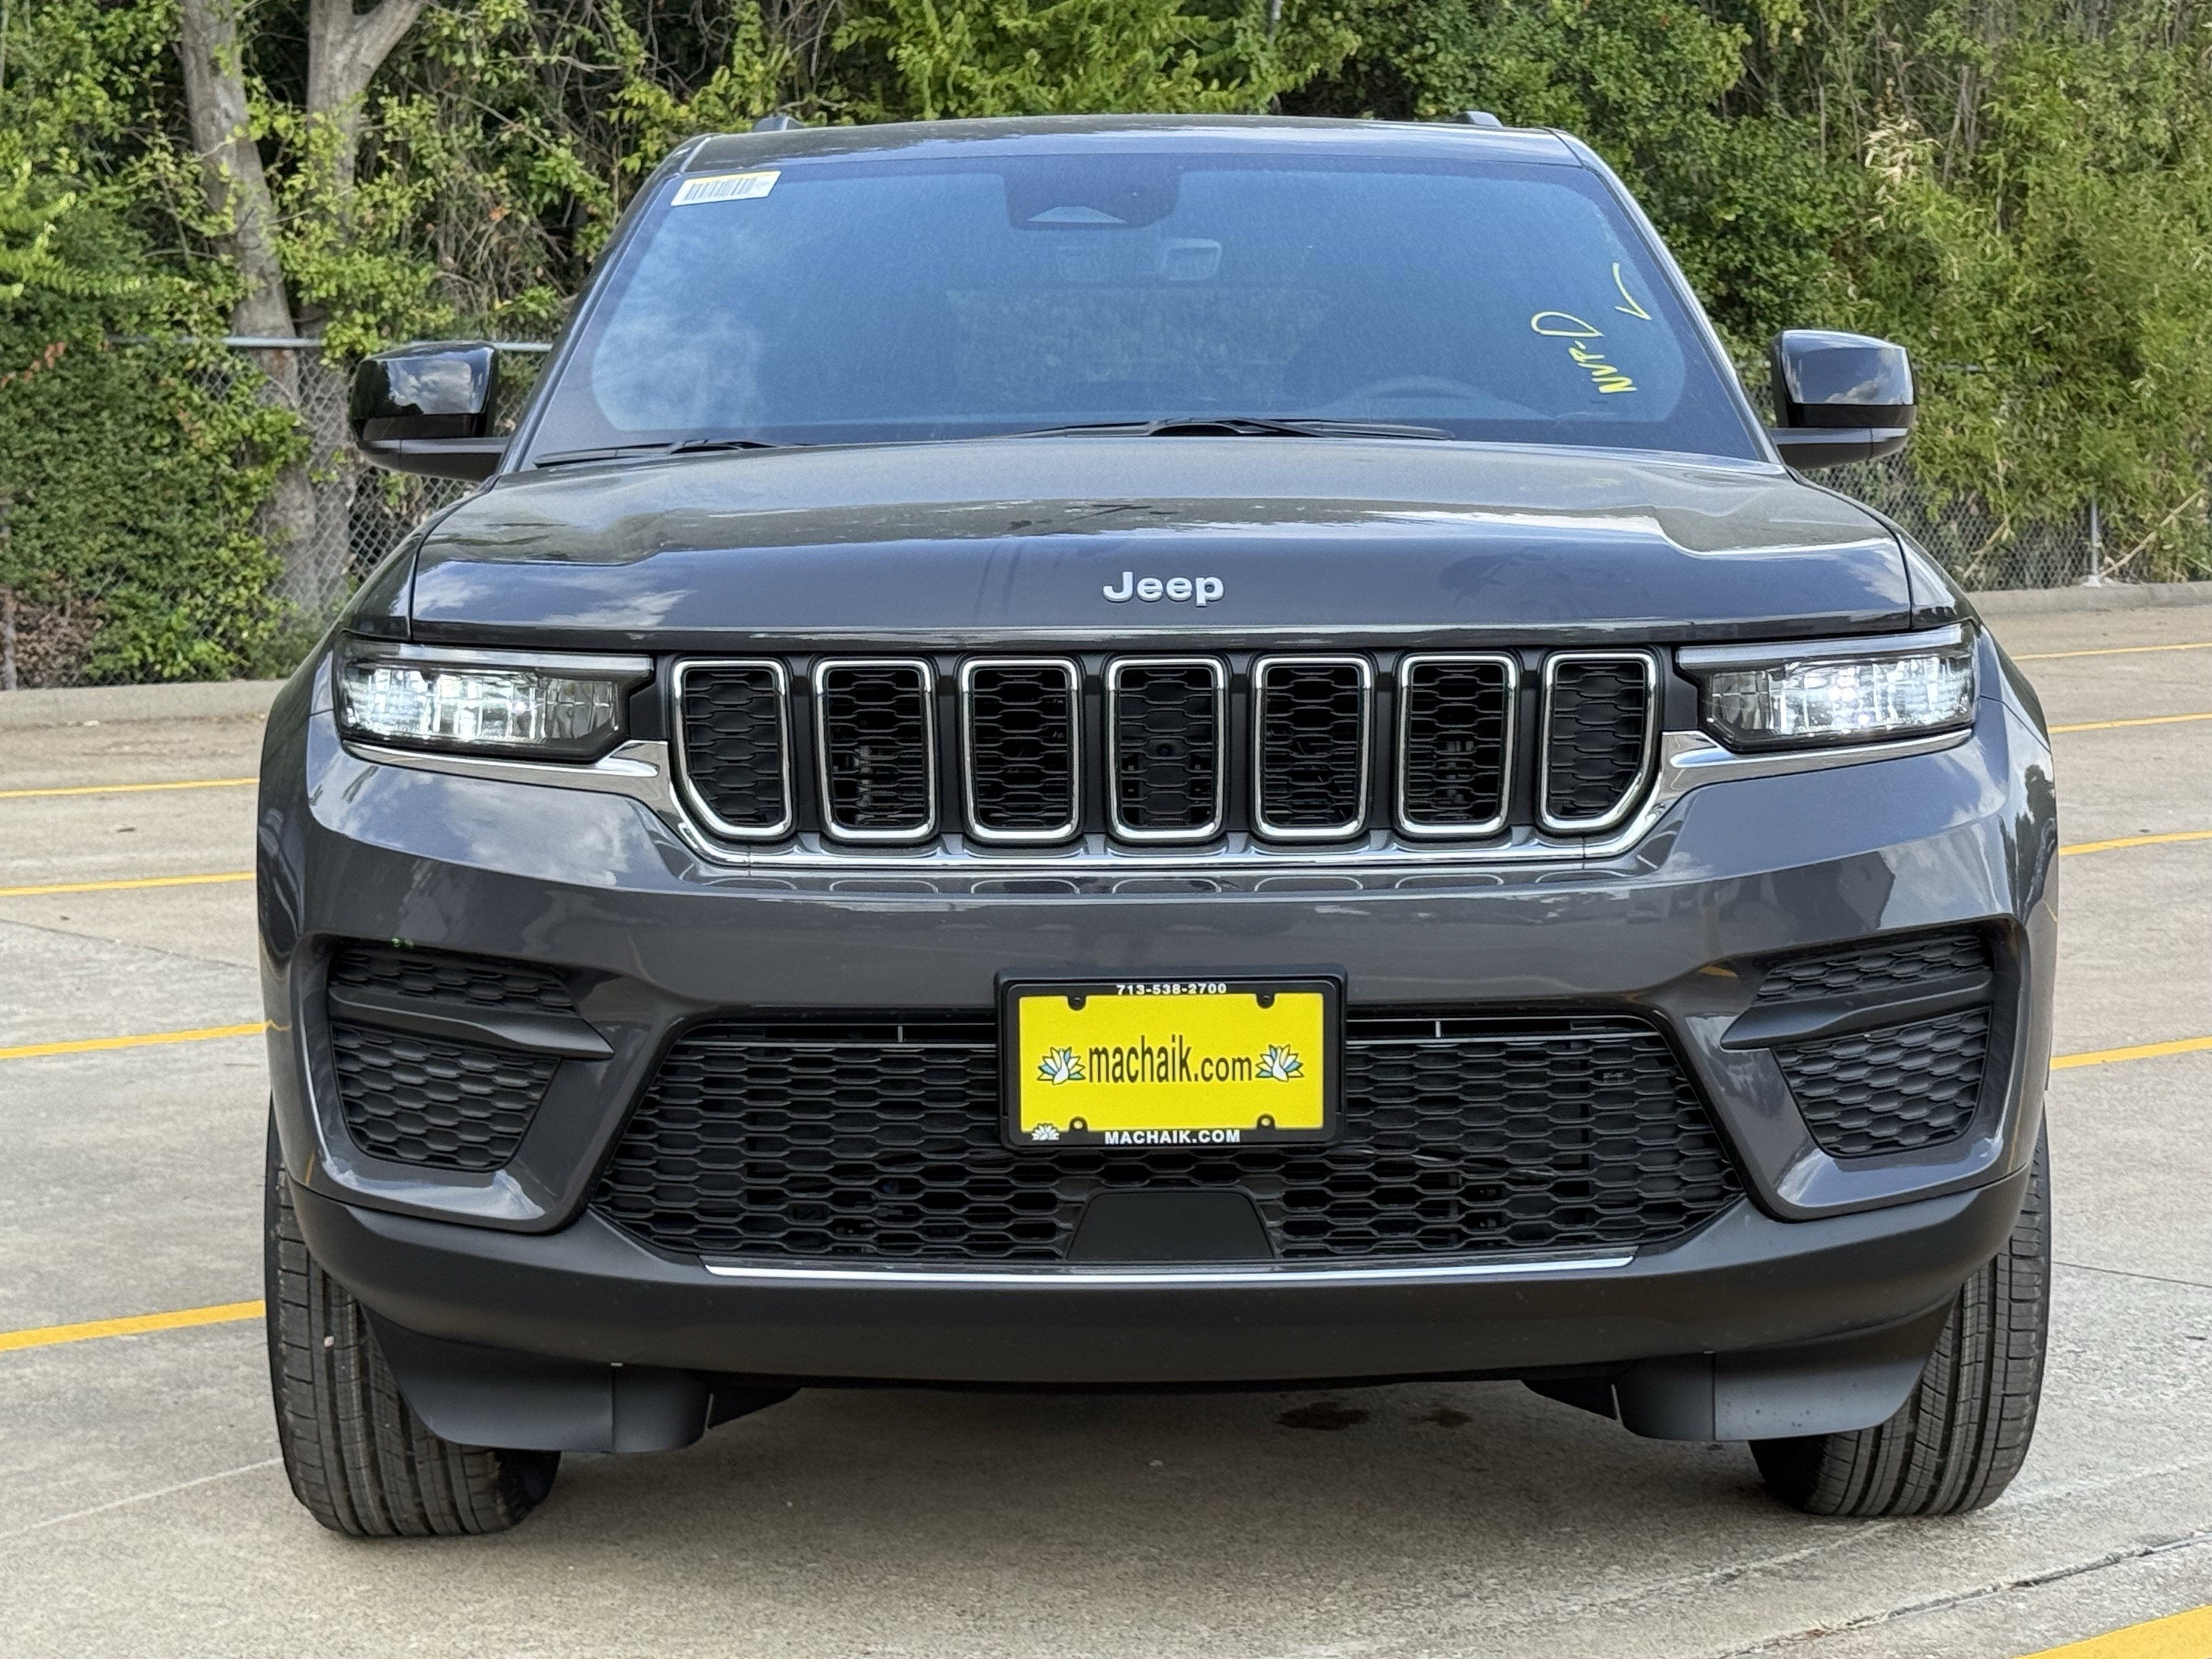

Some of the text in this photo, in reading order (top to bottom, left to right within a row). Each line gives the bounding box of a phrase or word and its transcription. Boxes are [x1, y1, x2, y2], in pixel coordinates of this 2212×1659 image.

[1103, 571, 1224, 607] Jeep
[1116, 983, 1227, 995] 713-538-2700
[1088, 1034, 1252, 1083] machaik.com
[1104, 1130, 1240, 1145] MACHAIK.COM
